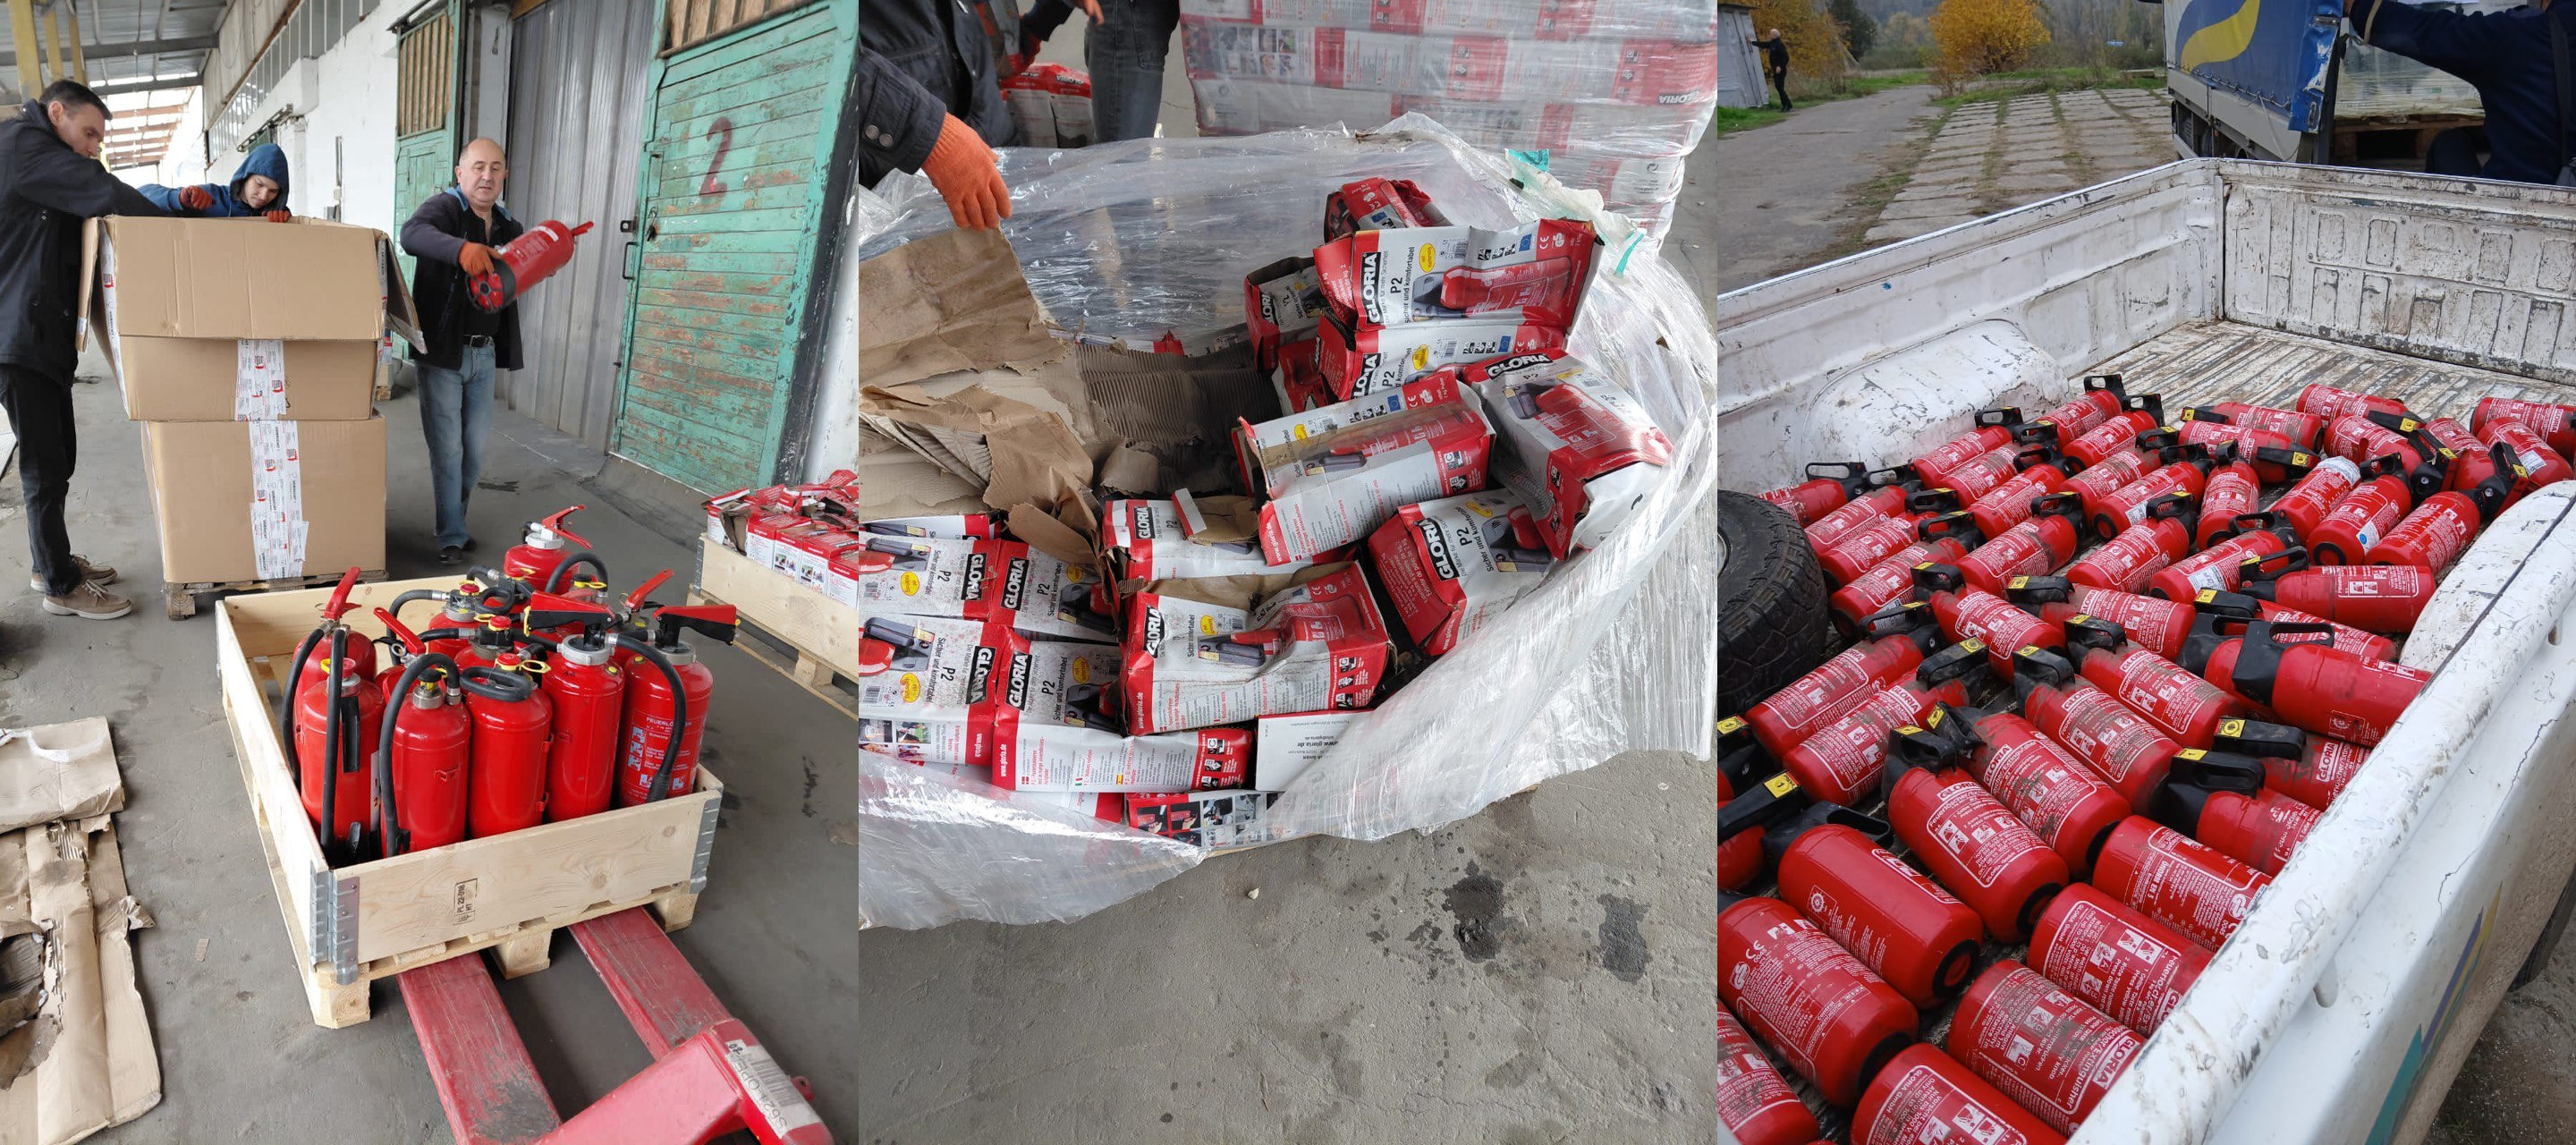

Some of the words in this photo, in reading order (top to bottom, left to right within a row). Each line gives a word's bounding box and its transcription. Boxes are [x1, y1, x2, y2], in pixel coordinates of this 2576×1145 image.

[699, 116, 734, 197] 2
[1538, 236, 1548, 250] CE
[1402, 246, 1414, 287] komfortabel
[1368, 254, 1380, 325] GLORIA
[1391, 276, 1402, 294] P2
[1402, 289, 1410, 301] und
[1402, 303, 1411, 325] Sicher
[1487, 354, 1550, 378] GLORIA
[1382, 369, 1395, 388] P2
[1409, 396, 1417, 408] CE
[2552, 408, 2563, 433] GLORIA
[1137, 507, 1151, 539] GLORIA
[1166, 522, 1178, 530] P2
[1457, 527, 1472, 546] P2
[1472, 536, 1484, 550] und
[1479, 552, 1495, 573] Sicher
[937, 571, 952, 582] P2
[966, 554, 984, 601] GLORIA
[1004, 558, 1026, 609] GLORIA
[1037, 583, 1050, 596] P2
[1148, 609, 1161, 656] GLORIA
[935, 638, 946, 658] Sicher
[933, 659, 941, 670] und
[941, 667, 956, 682] P2
[1056, 657, 1068, 691] komfortabel
[970, 648, 993, 703] GLORIA
[1009, 654, 1029, 708] GLORIA
[926, 670, 940, 704] komfortabel
[1042, 680, 1055, 695] P2
[2063, 688, 2096, 709] GLORIA
[1053, 704, 1061, 721] Sicher
[1138, 692, 1146, 728] www.gloria.de
[1985, 745, 2011, 785] GLORIA
[2319, 742, 2335, 781] GLORIA
[1744, 939, 1766, 962] CE
[2101, 961, 2110, 970] A
[2111, 959, 2122, 976] Press
[2117, 962, 2128, 978] Rote
[2129, 969, 2140, 987] Press
[2122, 987, 2133, 1007] yellow
[1817, 1001, 1835, 1022] Control
[2017, 1056, 2028, 1067] C
[2095, 1038, 2136, 1089] GLORIA
[1914, 1089, 1924, 1099] up
[1922, 1078, 1936, 1092] Only
[1911, 1085, 1936, 1115] Attention
[1920, 1094, 1943, 1123] Vorsicht
[1910, 1112, 1923, 1127] 1000
